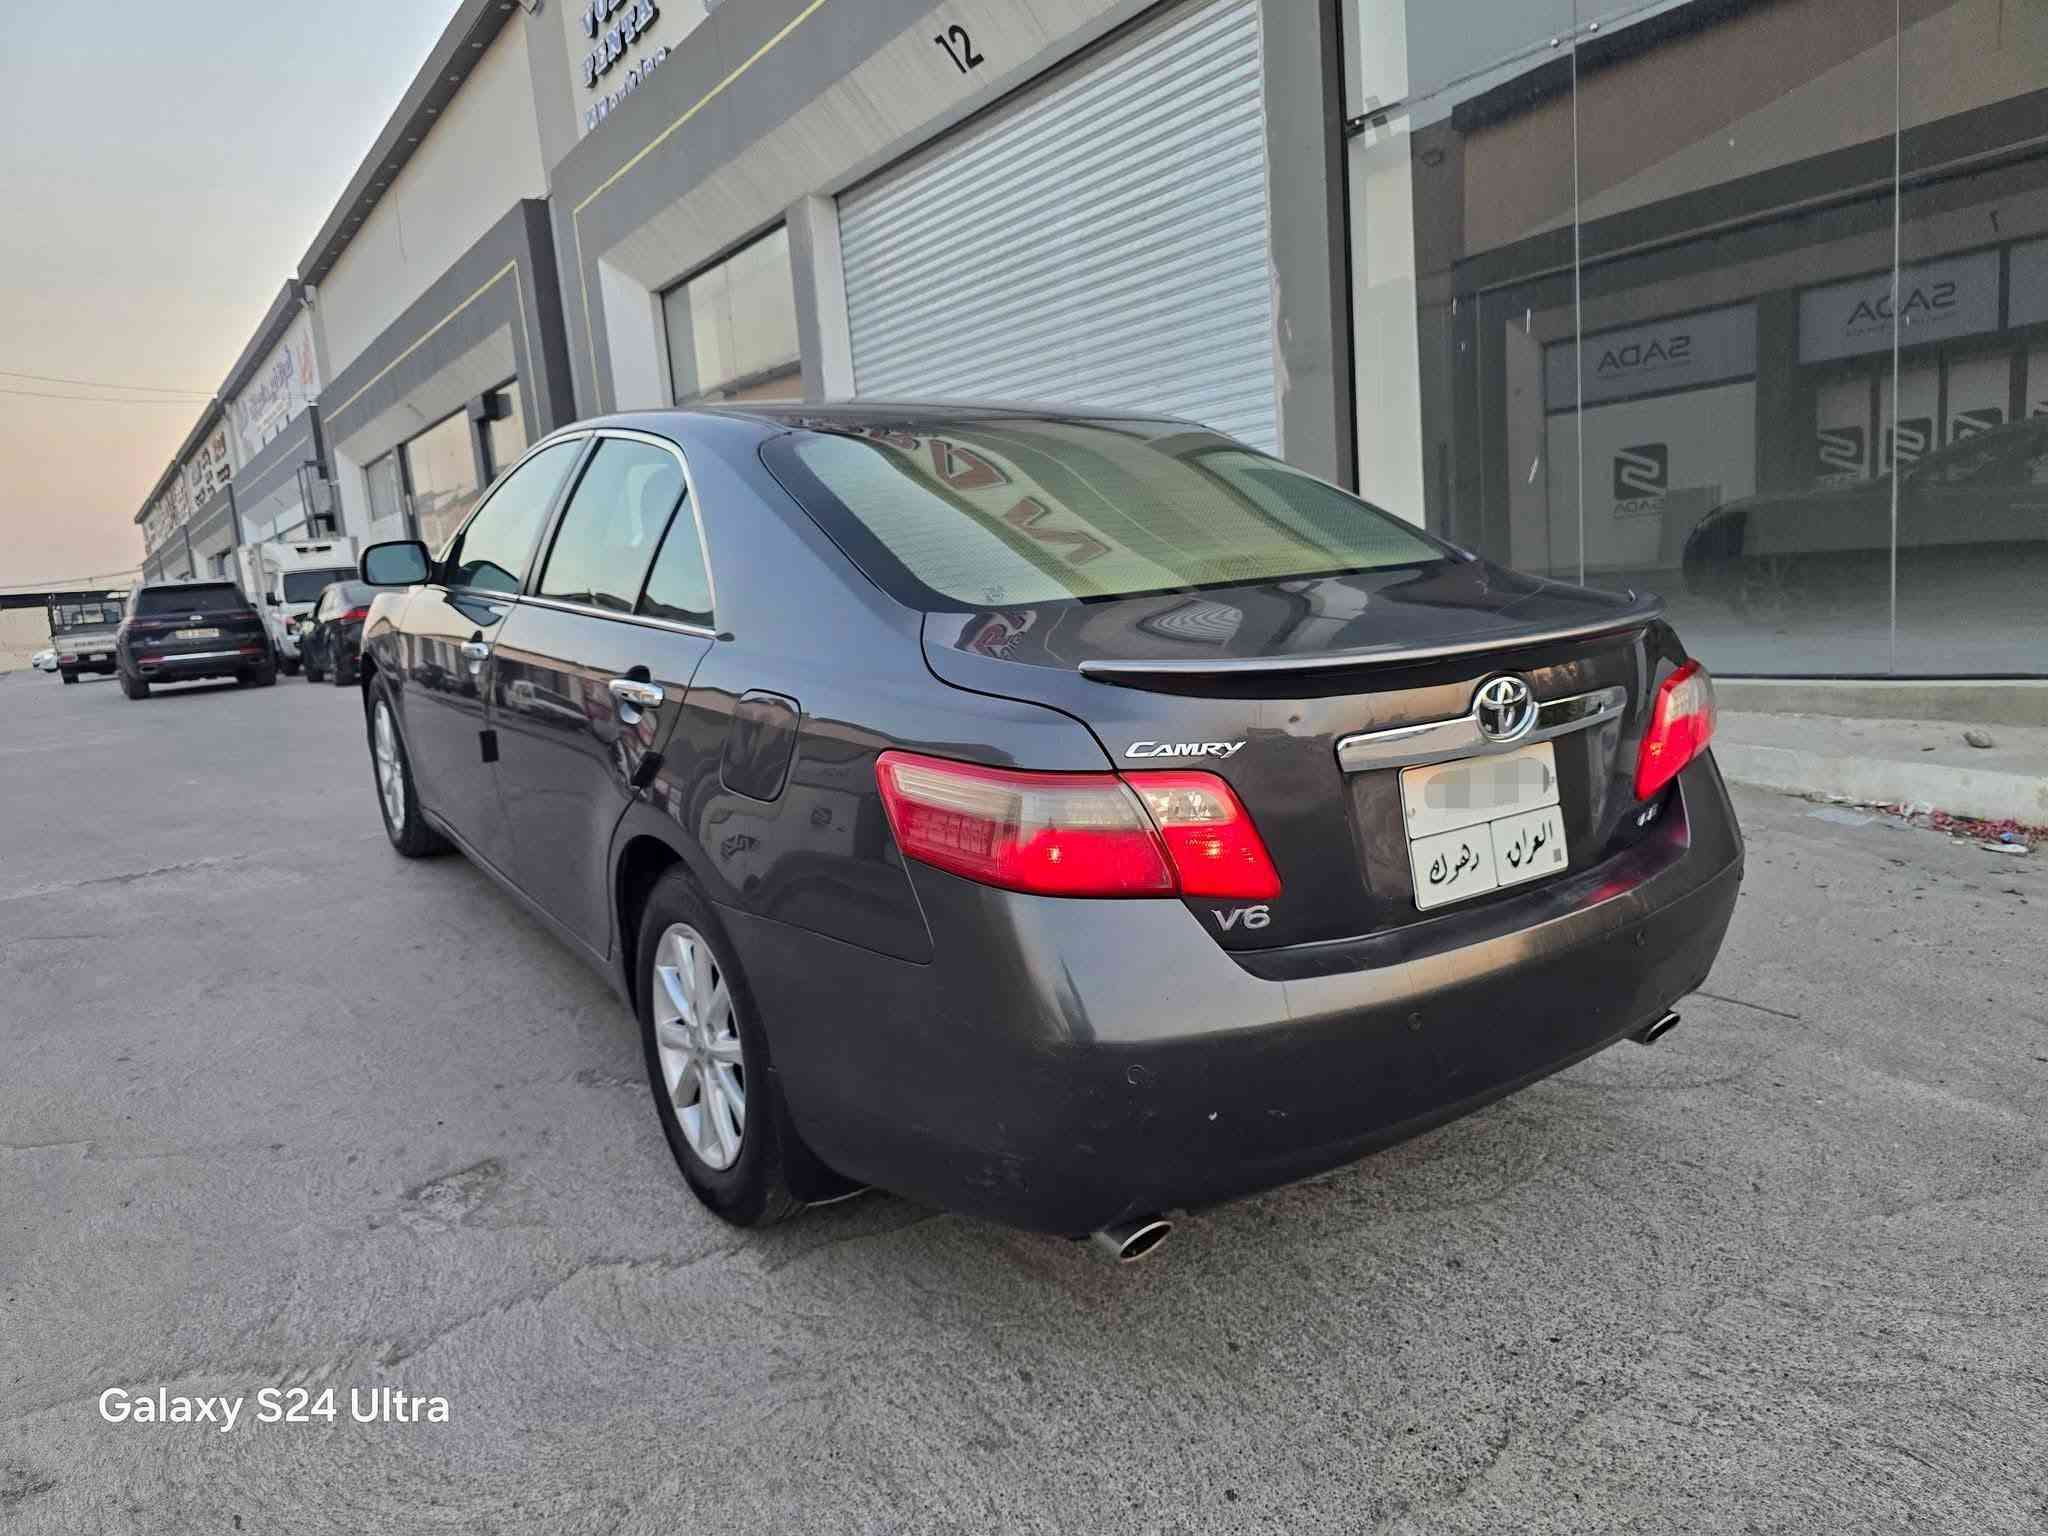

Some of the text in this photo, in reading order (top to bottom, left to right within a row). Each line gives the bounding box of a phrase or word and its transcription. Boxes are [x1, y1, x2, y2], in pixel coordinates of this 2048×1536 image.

[584, 0, 657, 88] PENTA
[934, 25, 985, 73] 12
[1124, 740, 1247, 759] CAMRY
[1211, 905, 1271, 932] V6
